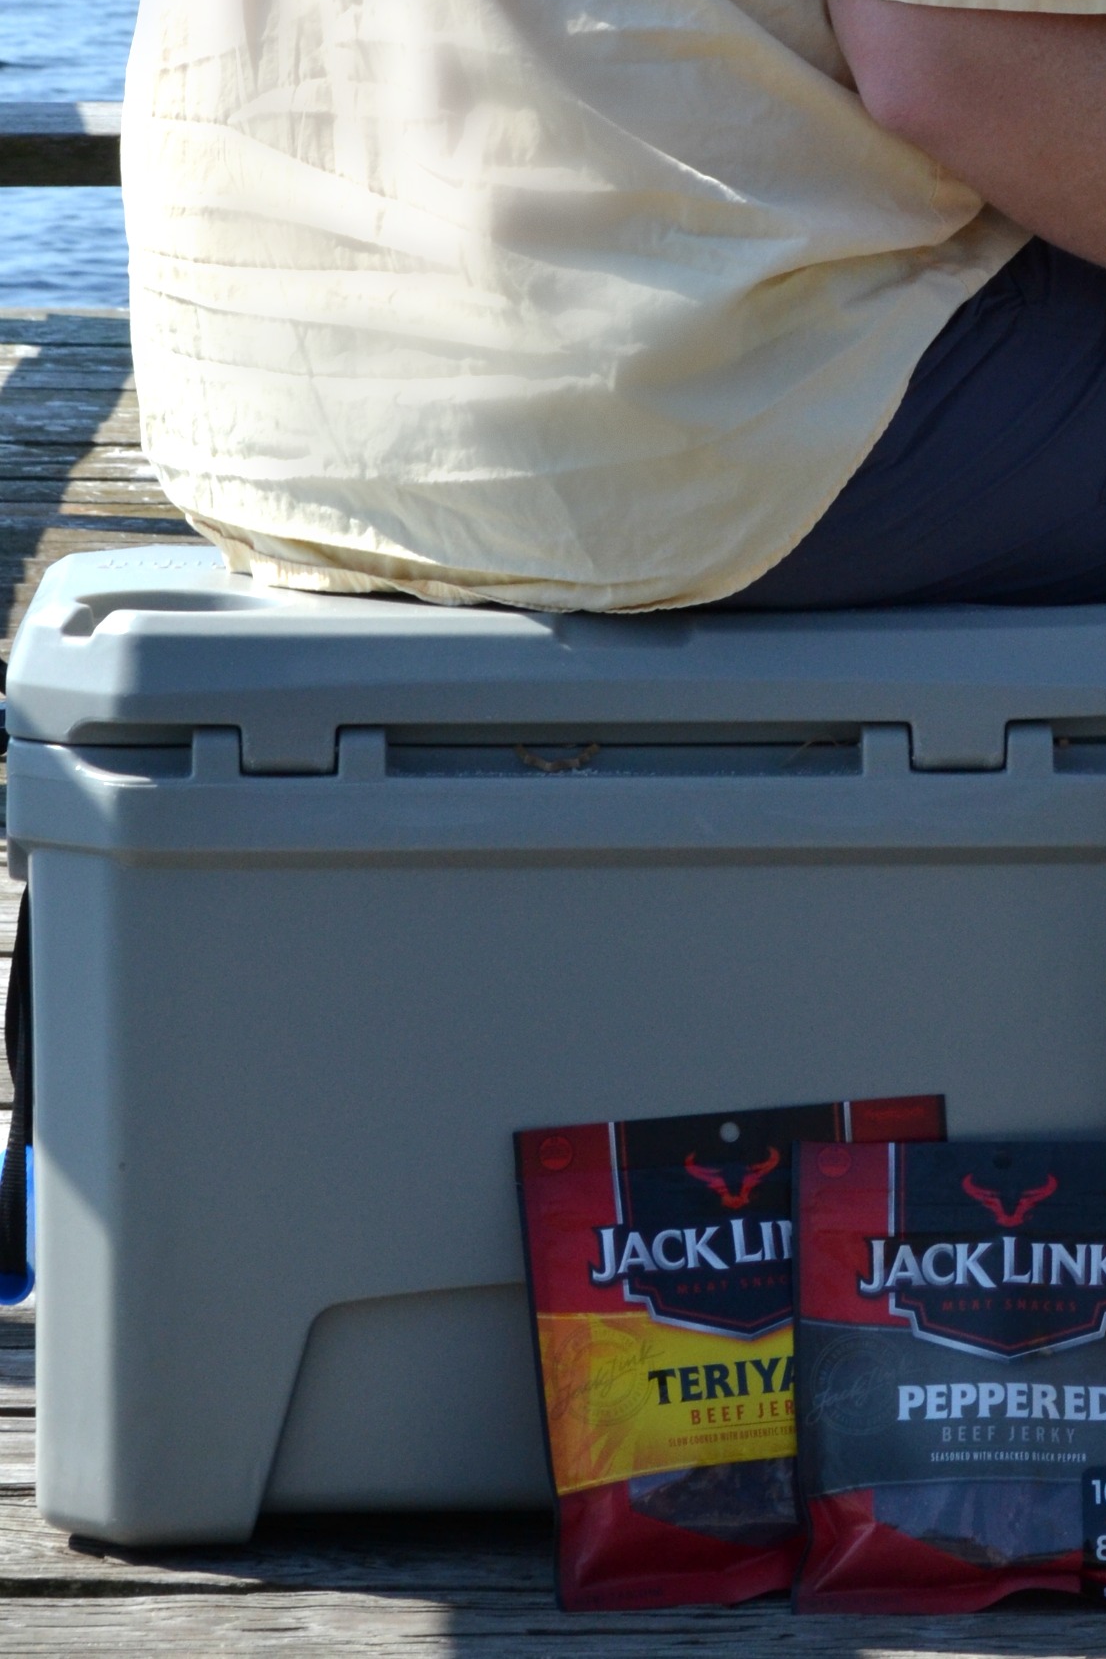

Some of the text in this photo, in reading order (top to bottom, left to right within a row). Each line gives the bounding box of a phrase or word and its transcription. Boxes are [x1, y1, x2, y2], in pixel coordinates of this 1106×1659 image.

[592, 1226, 730, 1282] JACK
[860, 1239, 997, 1294] JACK
[676, 1280, 730, 1295] MEAT
[942, 1299, 1077, 1313] MEAT SNACKS
[691, 1404, 745, 1425] BEEF
[669, 1437, 688, 1447] SLOW
[690, 1433, 718, 1445] COOKED
[720, 1431, 738, 1441] WITH
[942, 1425, 1077, 1444] BEEF JERKY
[930, 1450, 1087, 1463] SEASONED WITH CRACKED BLACK PEPPER
